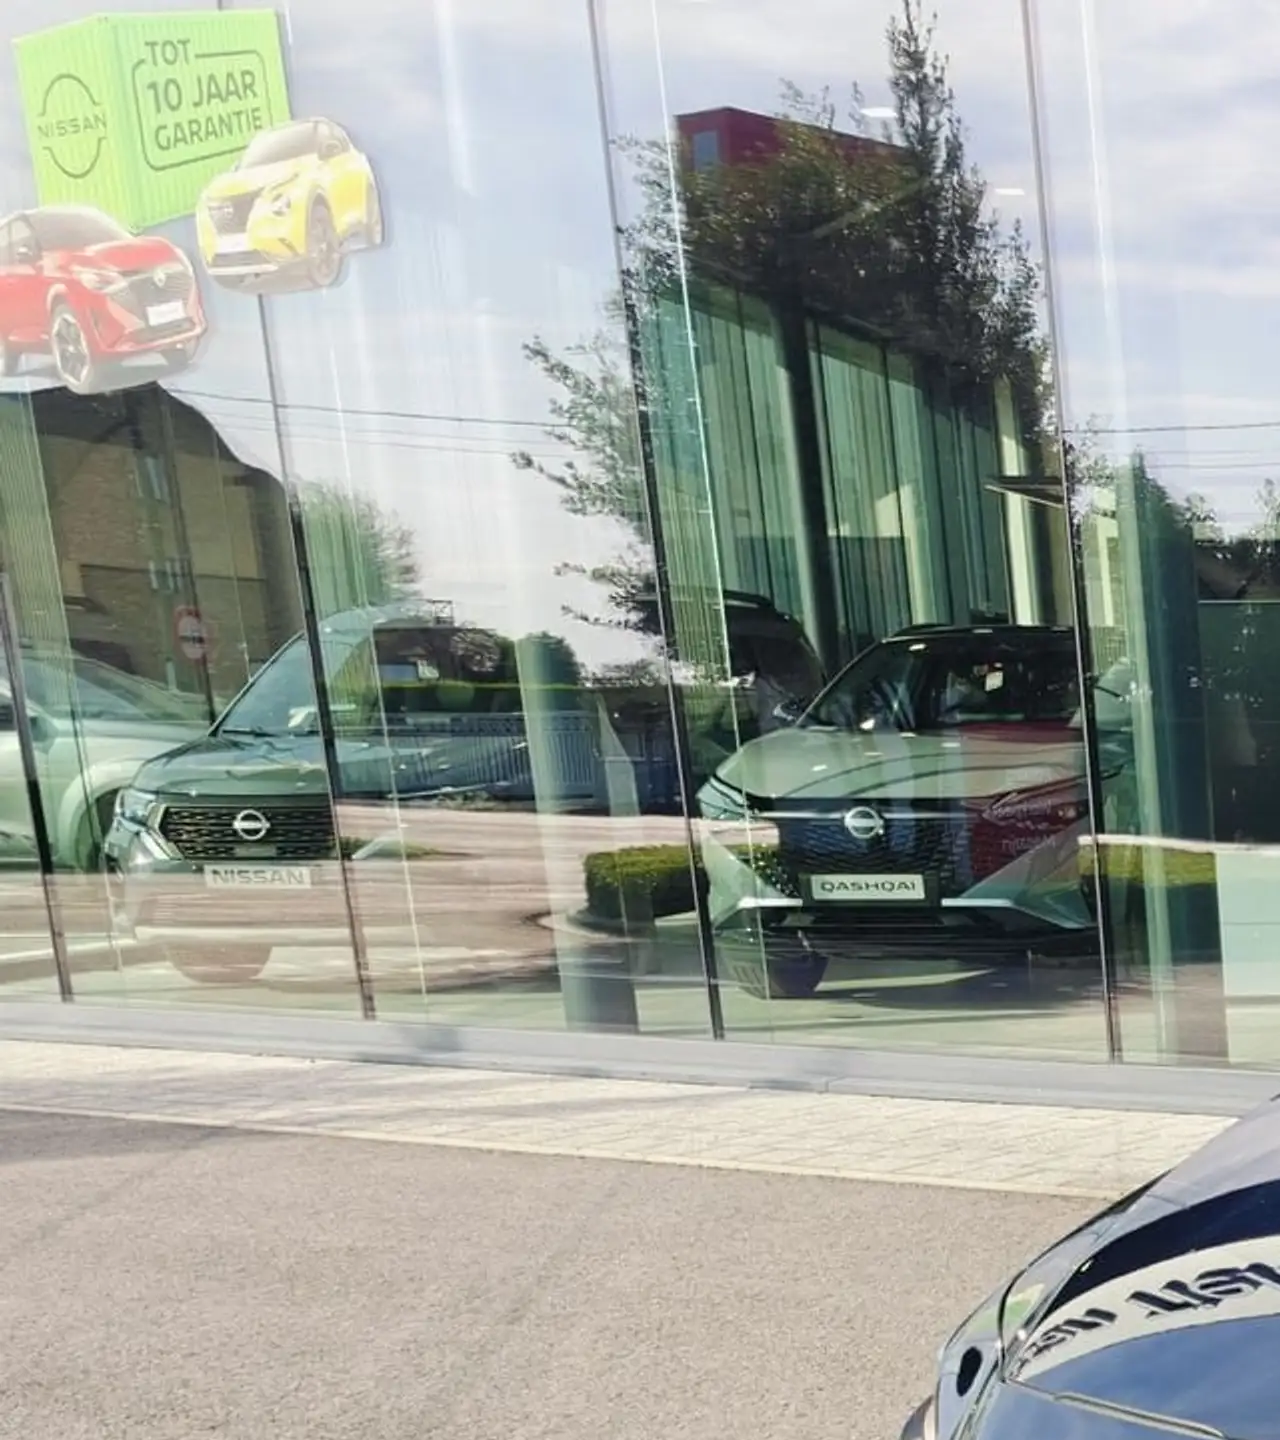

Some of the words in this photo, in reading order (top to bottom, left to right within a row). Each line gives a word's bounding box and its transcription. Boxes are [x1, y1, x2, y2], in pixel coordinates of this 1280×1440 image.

[145, 38, 191, 67] TOT
[147, 77, 182, 114] 10
[192, 69, 258, 108] JAAR
[37, 112, 107, 138] NISSAN
[154, 106, 262, 151] GARANTIE
[210, 868, 306, 885] NISSAN
[820, 881, 916, 894] QASHQAI
